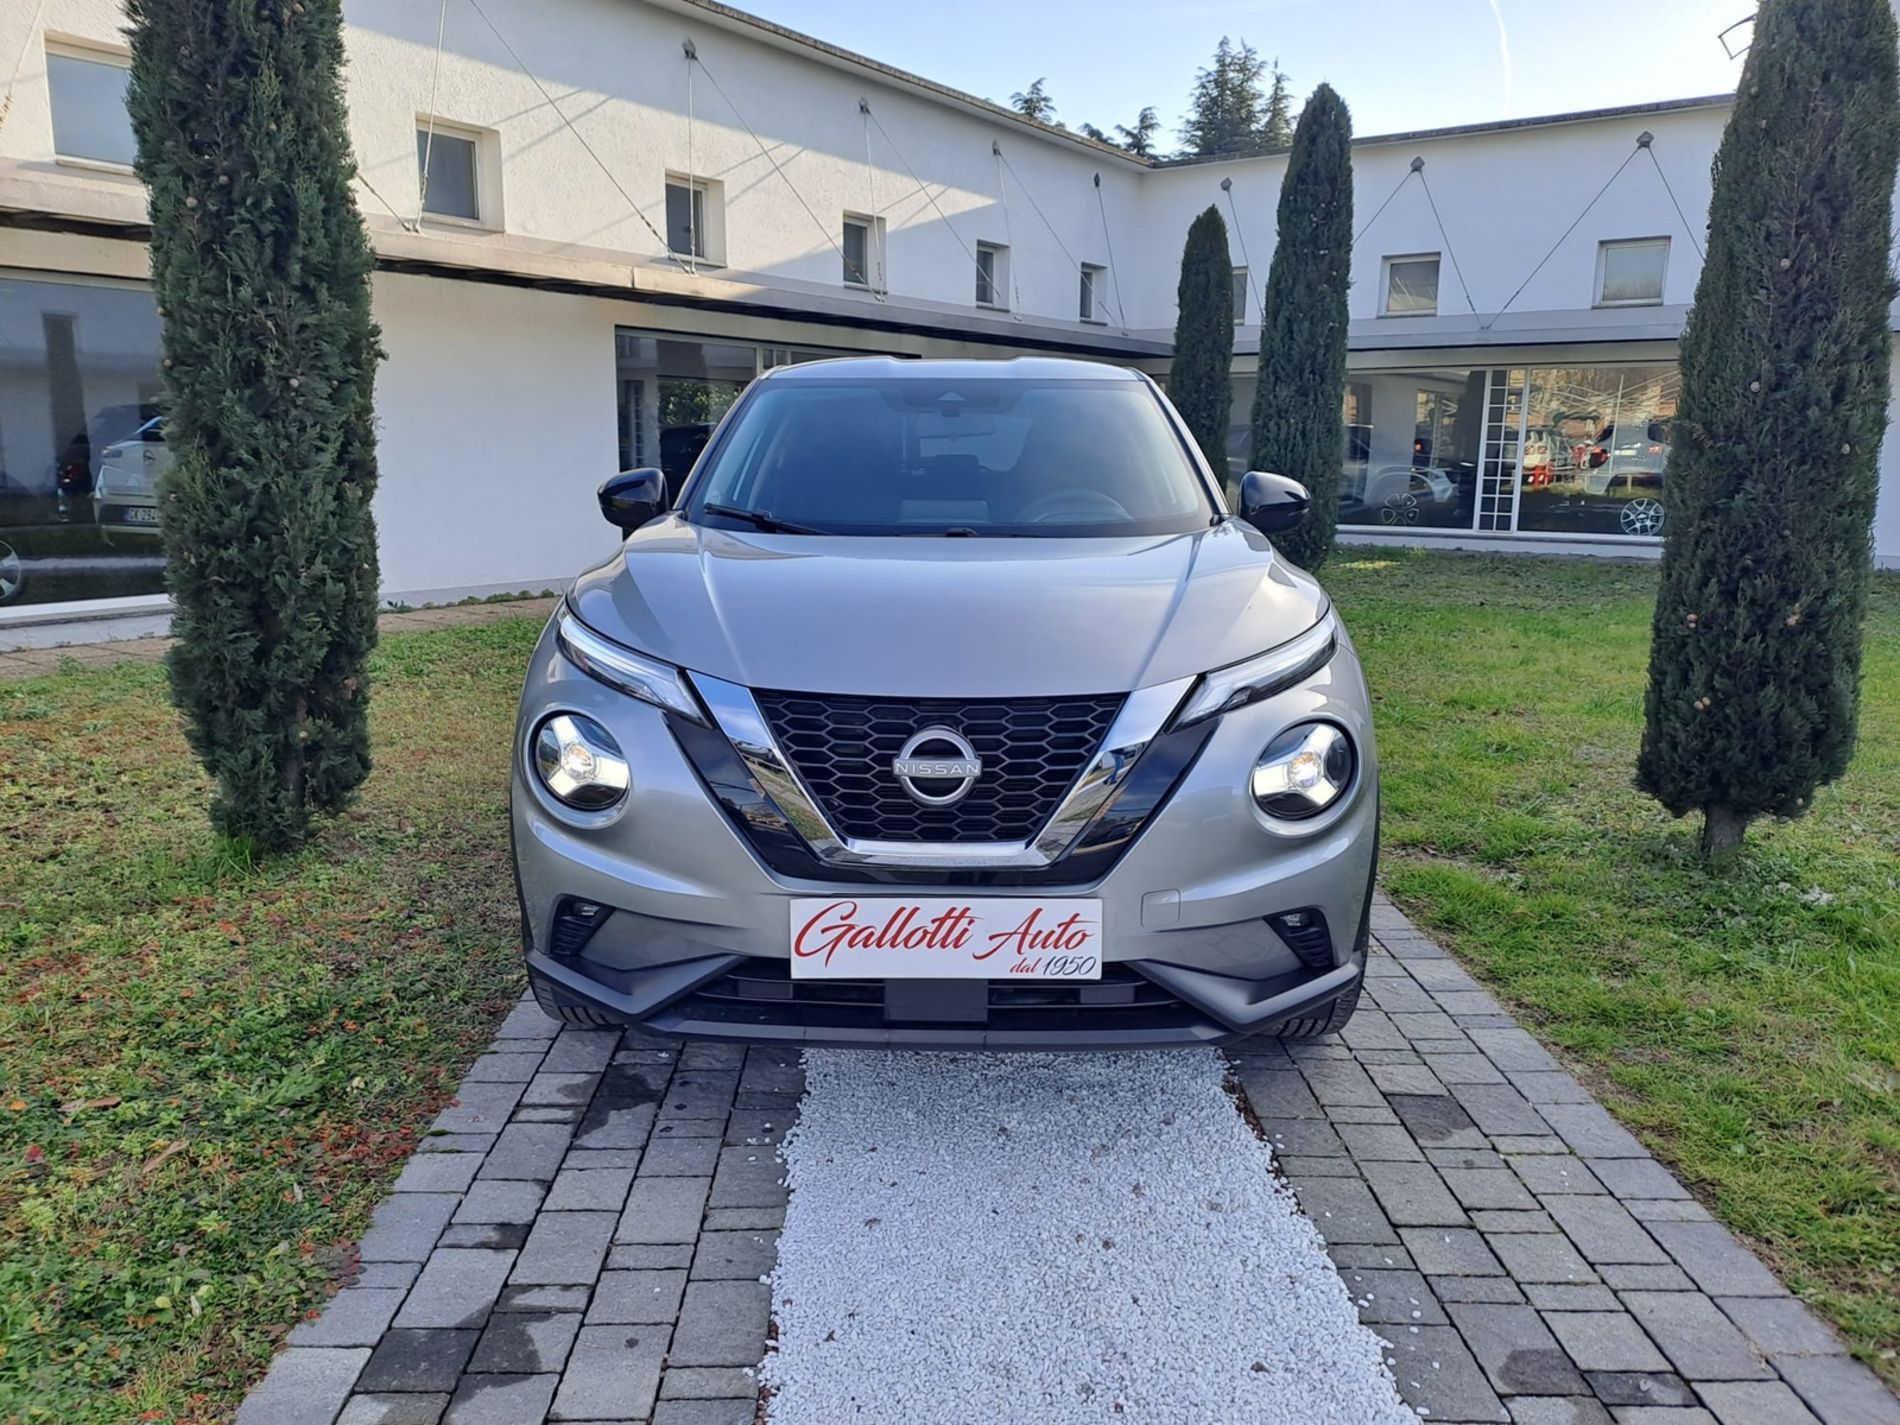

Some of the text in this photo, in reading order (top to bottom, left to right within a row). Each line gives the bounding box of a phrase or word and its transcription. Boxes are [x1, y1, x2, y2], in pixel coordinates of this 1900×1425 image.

[895, 763, 979, 775] NISSAN
[794, 900, 1098, 967] Gallotti Auto
[1009, 955, 1097, 976] dal 1950
